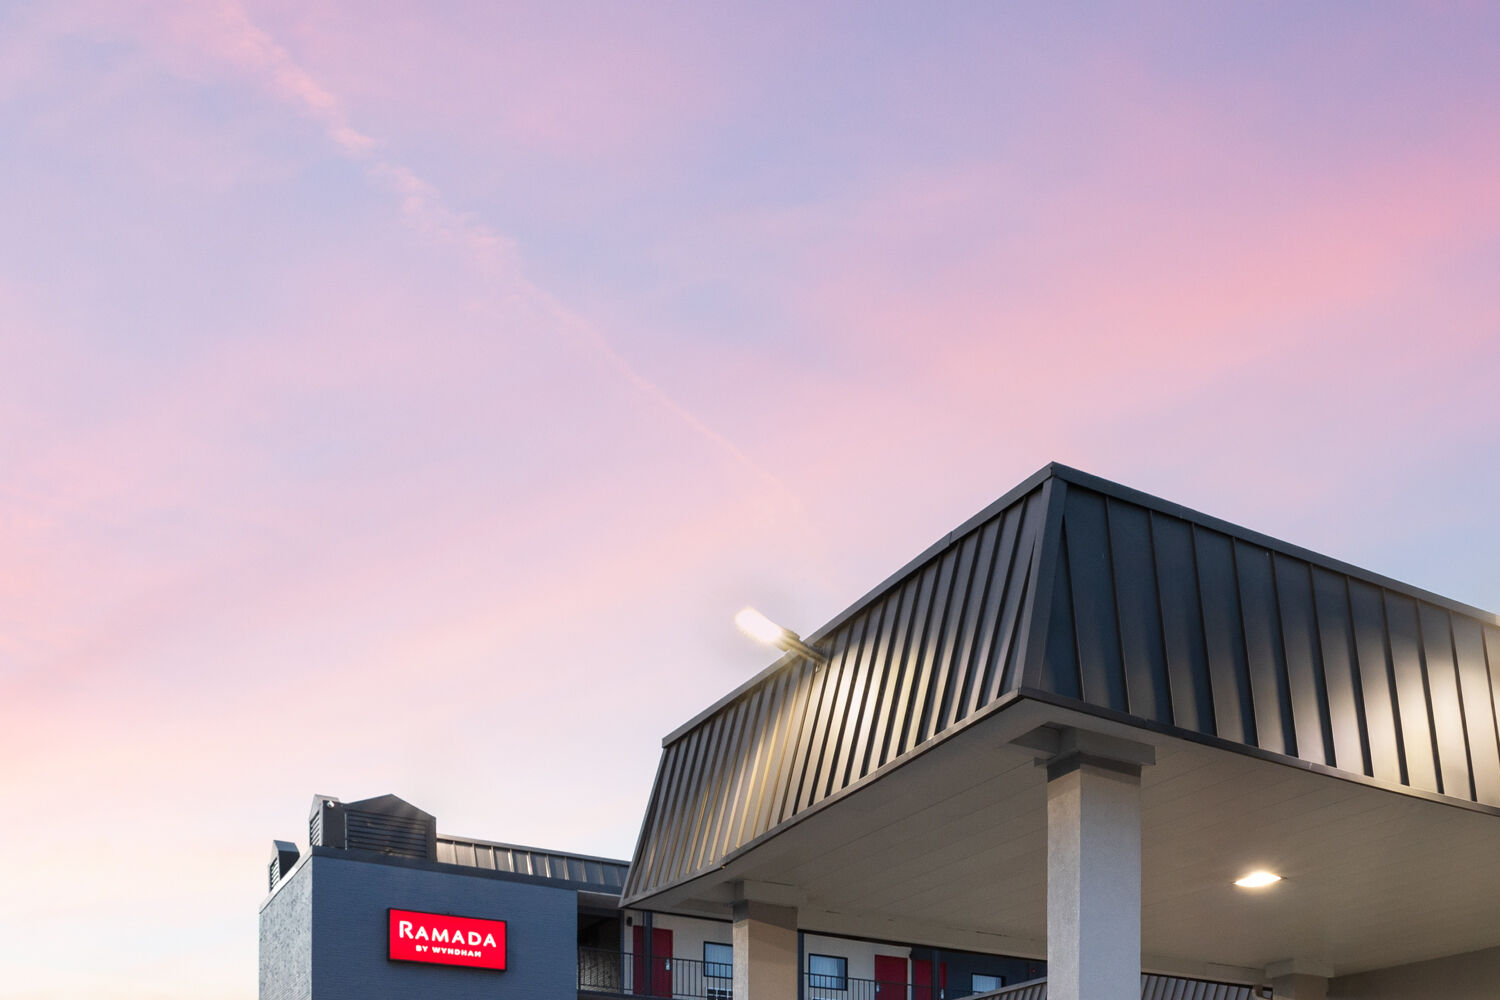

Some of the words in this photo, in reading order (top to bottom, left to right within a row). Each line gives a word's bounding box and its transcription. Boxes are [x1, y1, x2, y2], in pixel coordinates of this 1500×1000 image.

[399, 920, 497, 948] RAMADA
[415, 944, 428, 953] BY
[432, 946, 482, 958] WYNDHAM
